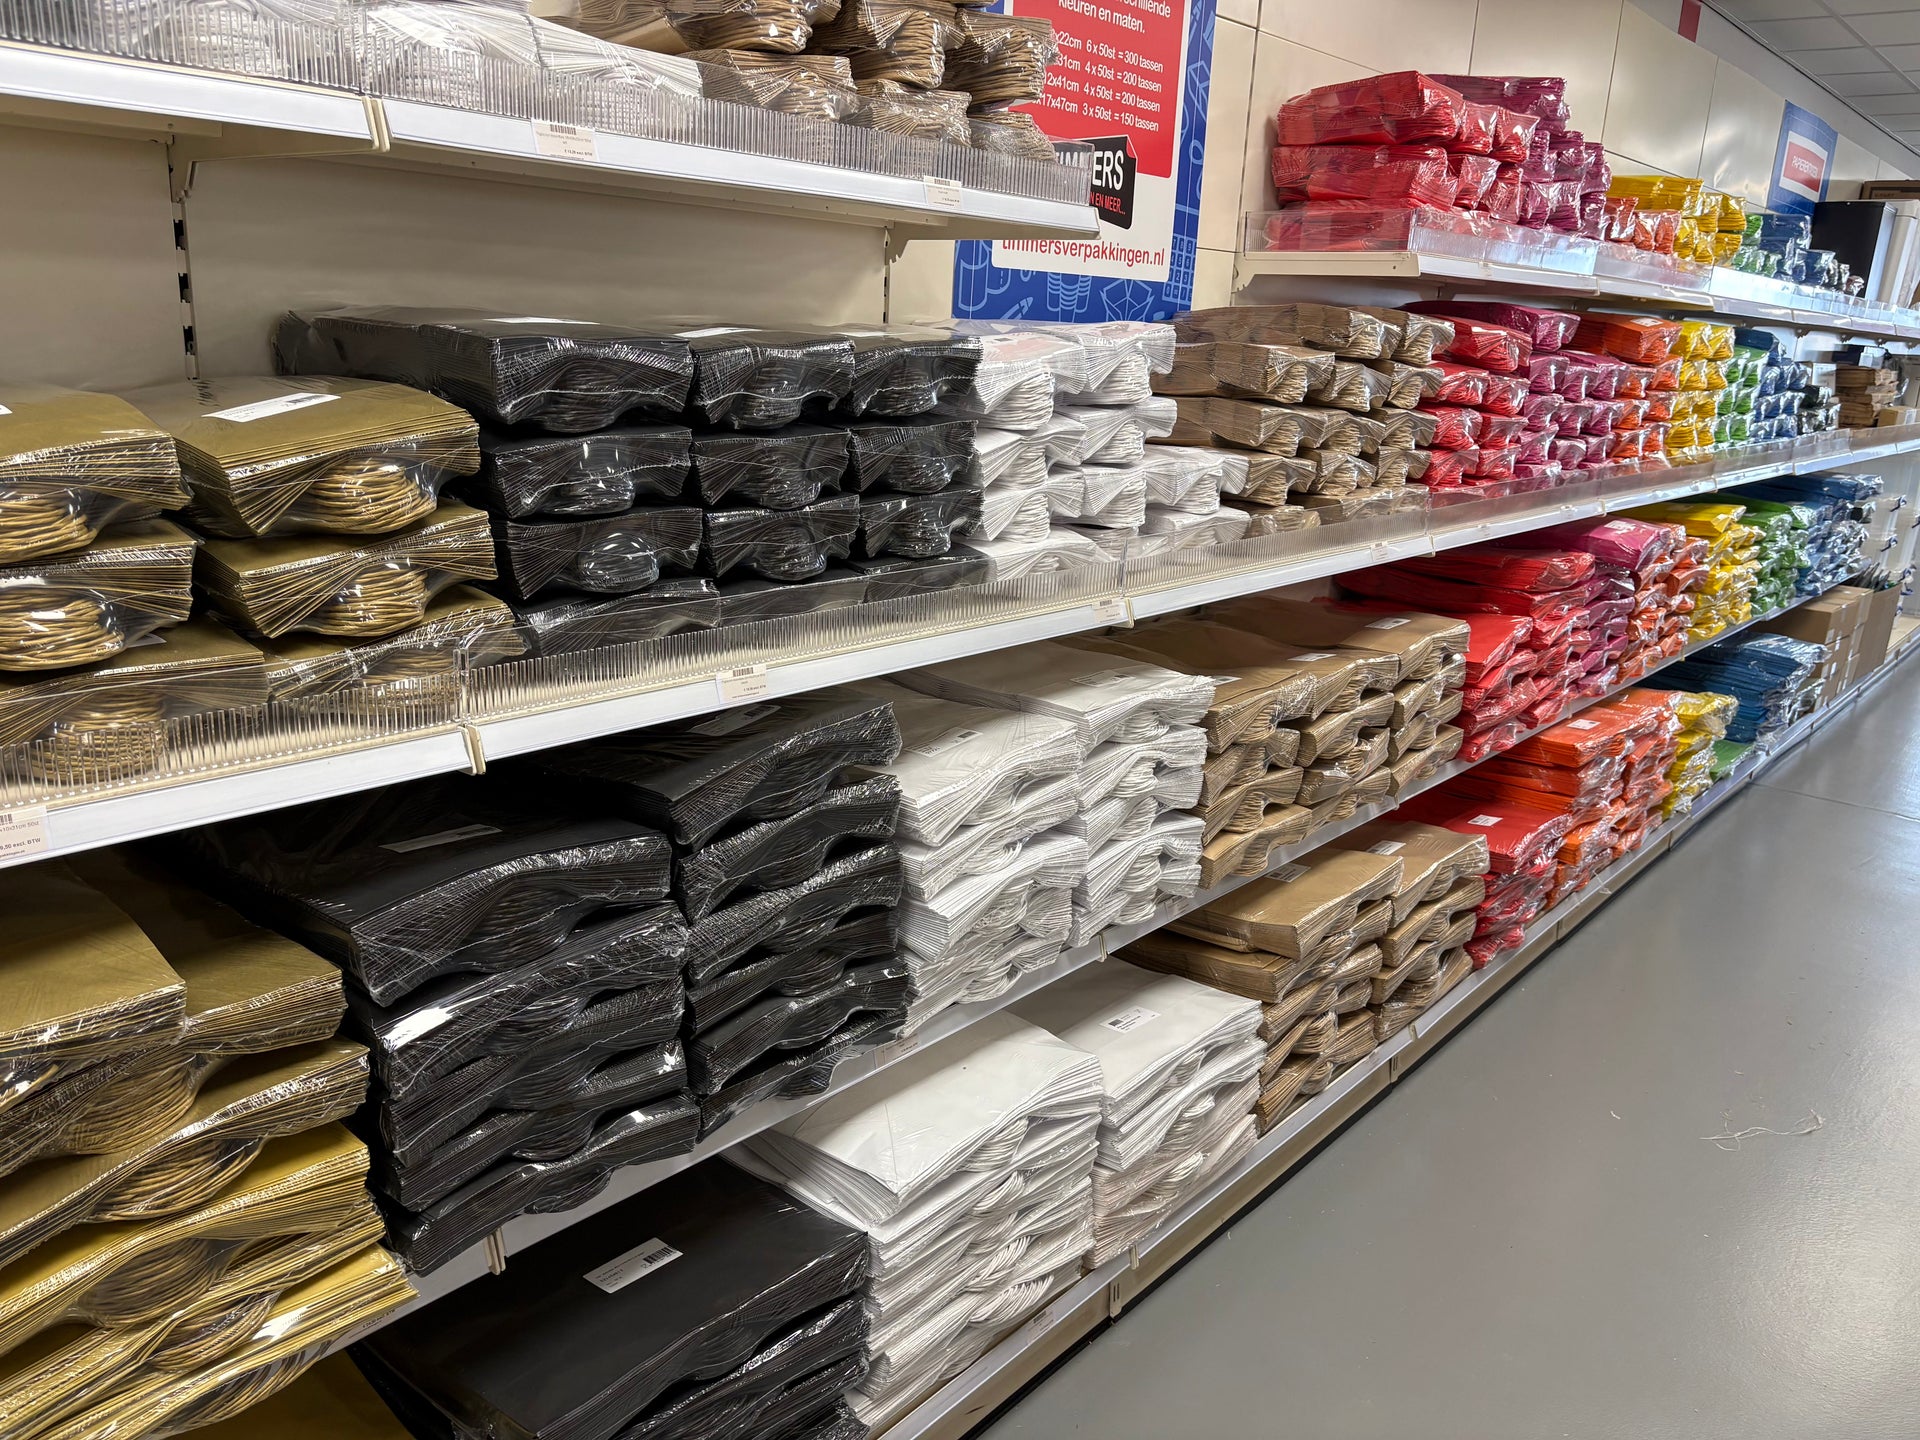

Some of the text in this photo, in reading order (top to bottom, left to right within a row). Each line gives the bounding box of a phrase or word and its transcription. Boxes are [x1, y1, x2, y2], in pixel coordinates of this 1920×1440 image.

[1098, 7, 1111, 23] en
[1113, 12, 1145, 34] maten.
[1086, 39, 1092, 53] 6
[1092, 45, 1098, 55] x
[1099, 43, 1116, 60] 50st
[1124, 50, 1139, 66] 300
[1139, 55, 1164, 73] tassen
[1084, 61, 1090, 74] 4
[1091, 66, 1097, 76] x
[1097, 65, 1115, 81] 50st
[1122, 71, 1137, 87] 200
[1137, 75, 1162, 93] tassen
[1083, 82, 1090, 95] 4
[1090, 87, 1095, 97] x
[1096, 86, 1113, 101] 50st
[1121, 91, 1136, 107] 200
[1136, 95, 1160, 113] tassen
[1082, 102, 1088, 116] 3
[1088, 108, 1094, 118] x
[1094, 106, 1112, 121] 50st
[1120, 112, 1135, 127] 150
[1135, 115, 1159, 132] tassen
[1002, 239, 1165, 267] timmersverpakkingen.nl
